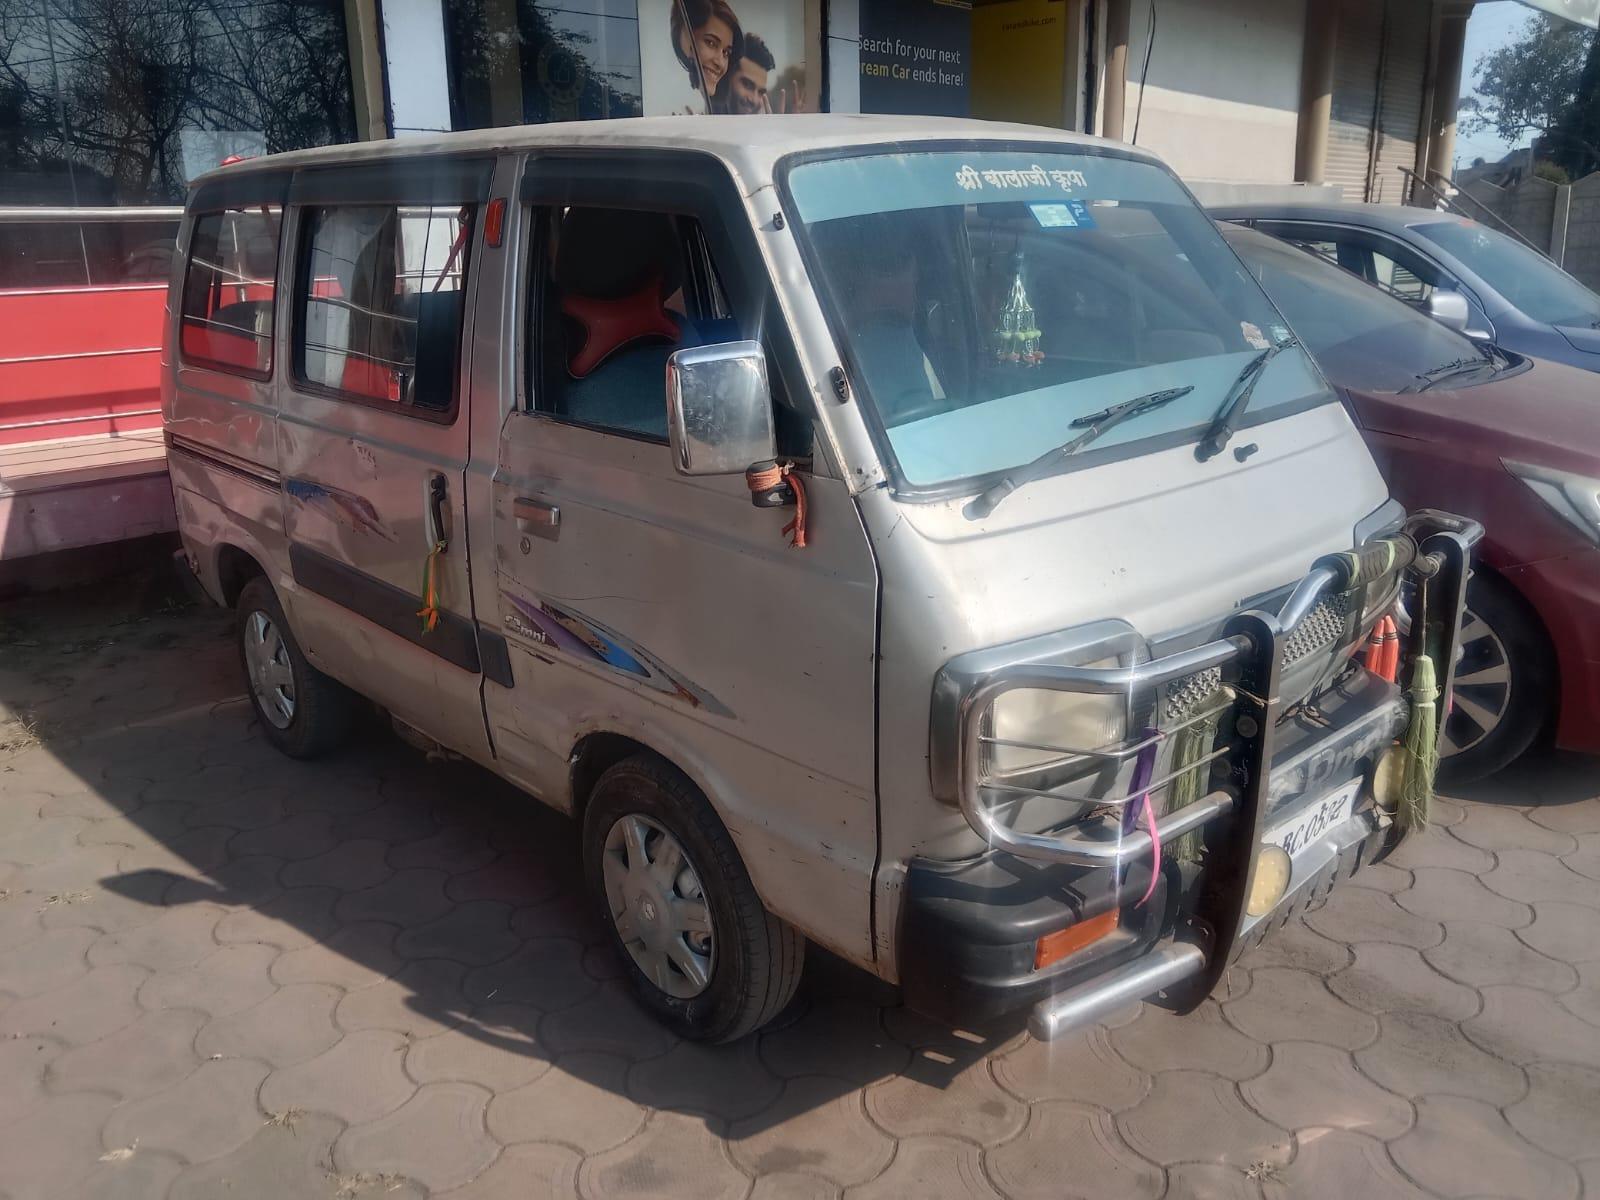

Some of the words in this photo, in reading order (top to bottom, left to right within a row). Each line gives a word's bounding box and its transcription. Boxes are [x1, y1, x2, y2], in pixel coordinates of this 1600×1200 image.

[895, 39, 912, 57] for
[913, 46, 936, 62] your
[939, 49, 961, 64] next
[892, 63, 911, 80] Car
[912, 66, 937, 83] ends
[939, 67, 964, 87] here!
[955, 164, 983, 191] श्री
[981, 164, 1051, 188] बालाजी
[1049, 169, 1088, 193] कृपा
